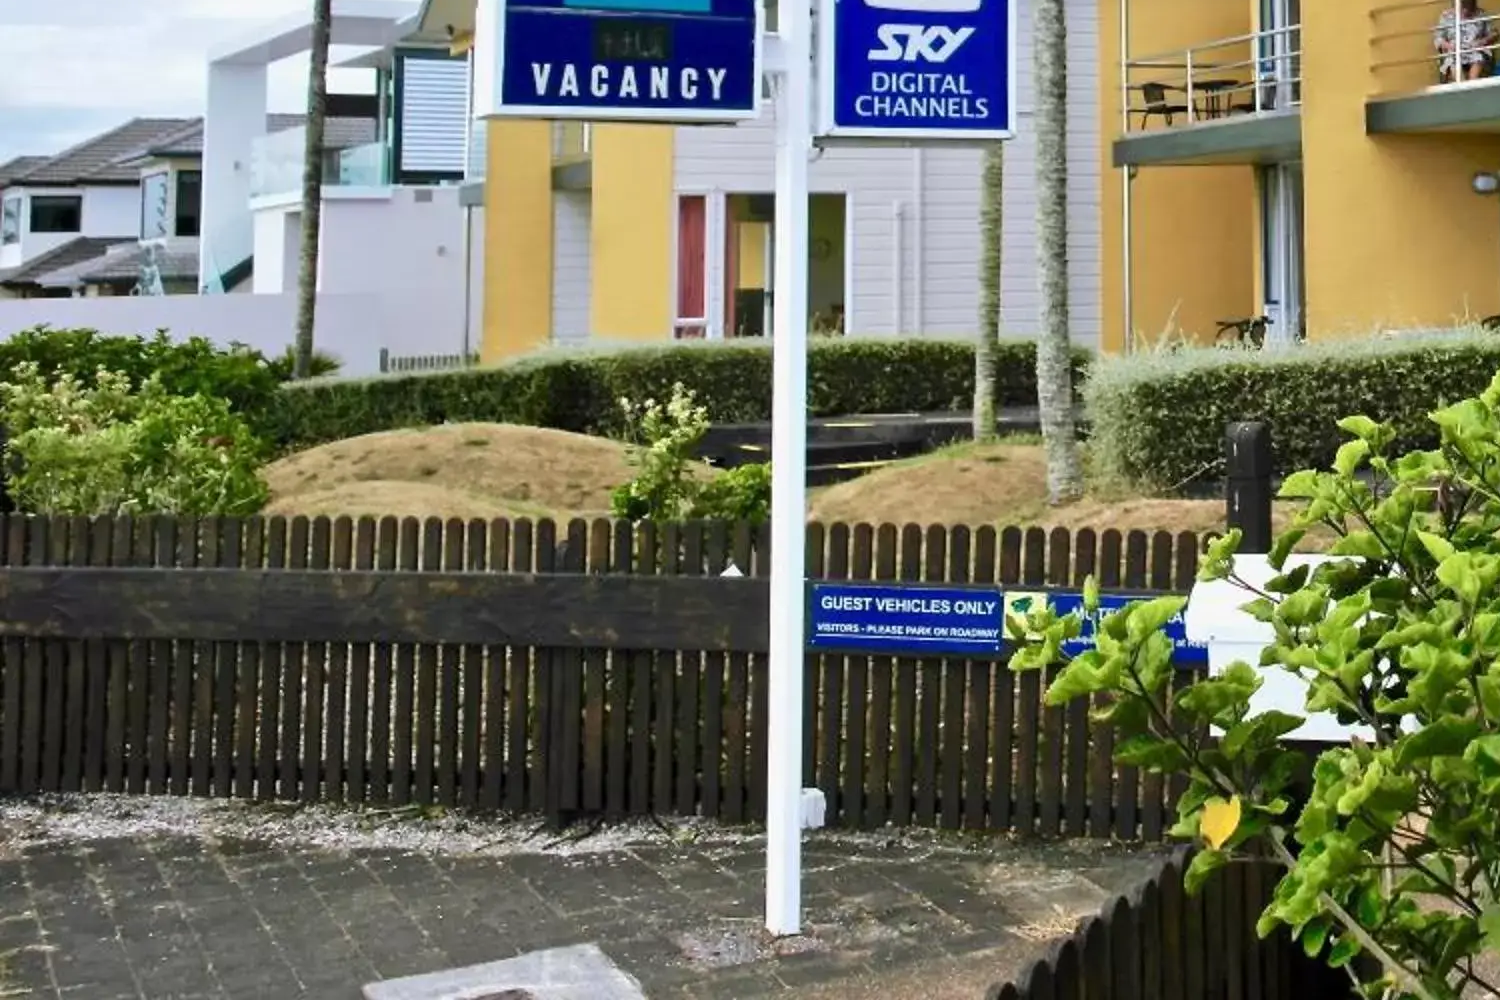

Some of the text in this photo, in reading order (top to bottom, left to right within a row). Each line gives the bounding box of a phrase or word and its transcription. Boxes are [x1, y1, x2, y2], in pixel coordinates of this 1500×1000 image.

[867, 23, 977, 62] SKY
[531, 62, 727, 101] VACANCY
[871, 71, 973, 95] DIGITAL
[855, 95, 989, 119] CHANNELS
[821, 595, 996, 615] GUEST VEHICLES ONLY
[817, 622, 859, 633] VISITORS
[867, 624, 904, 635] PLEASE
[905, 626, 931, 636] PARK
[933, 627, 949, 637] ON
[950, 628, 999, 639] ROADWAY
